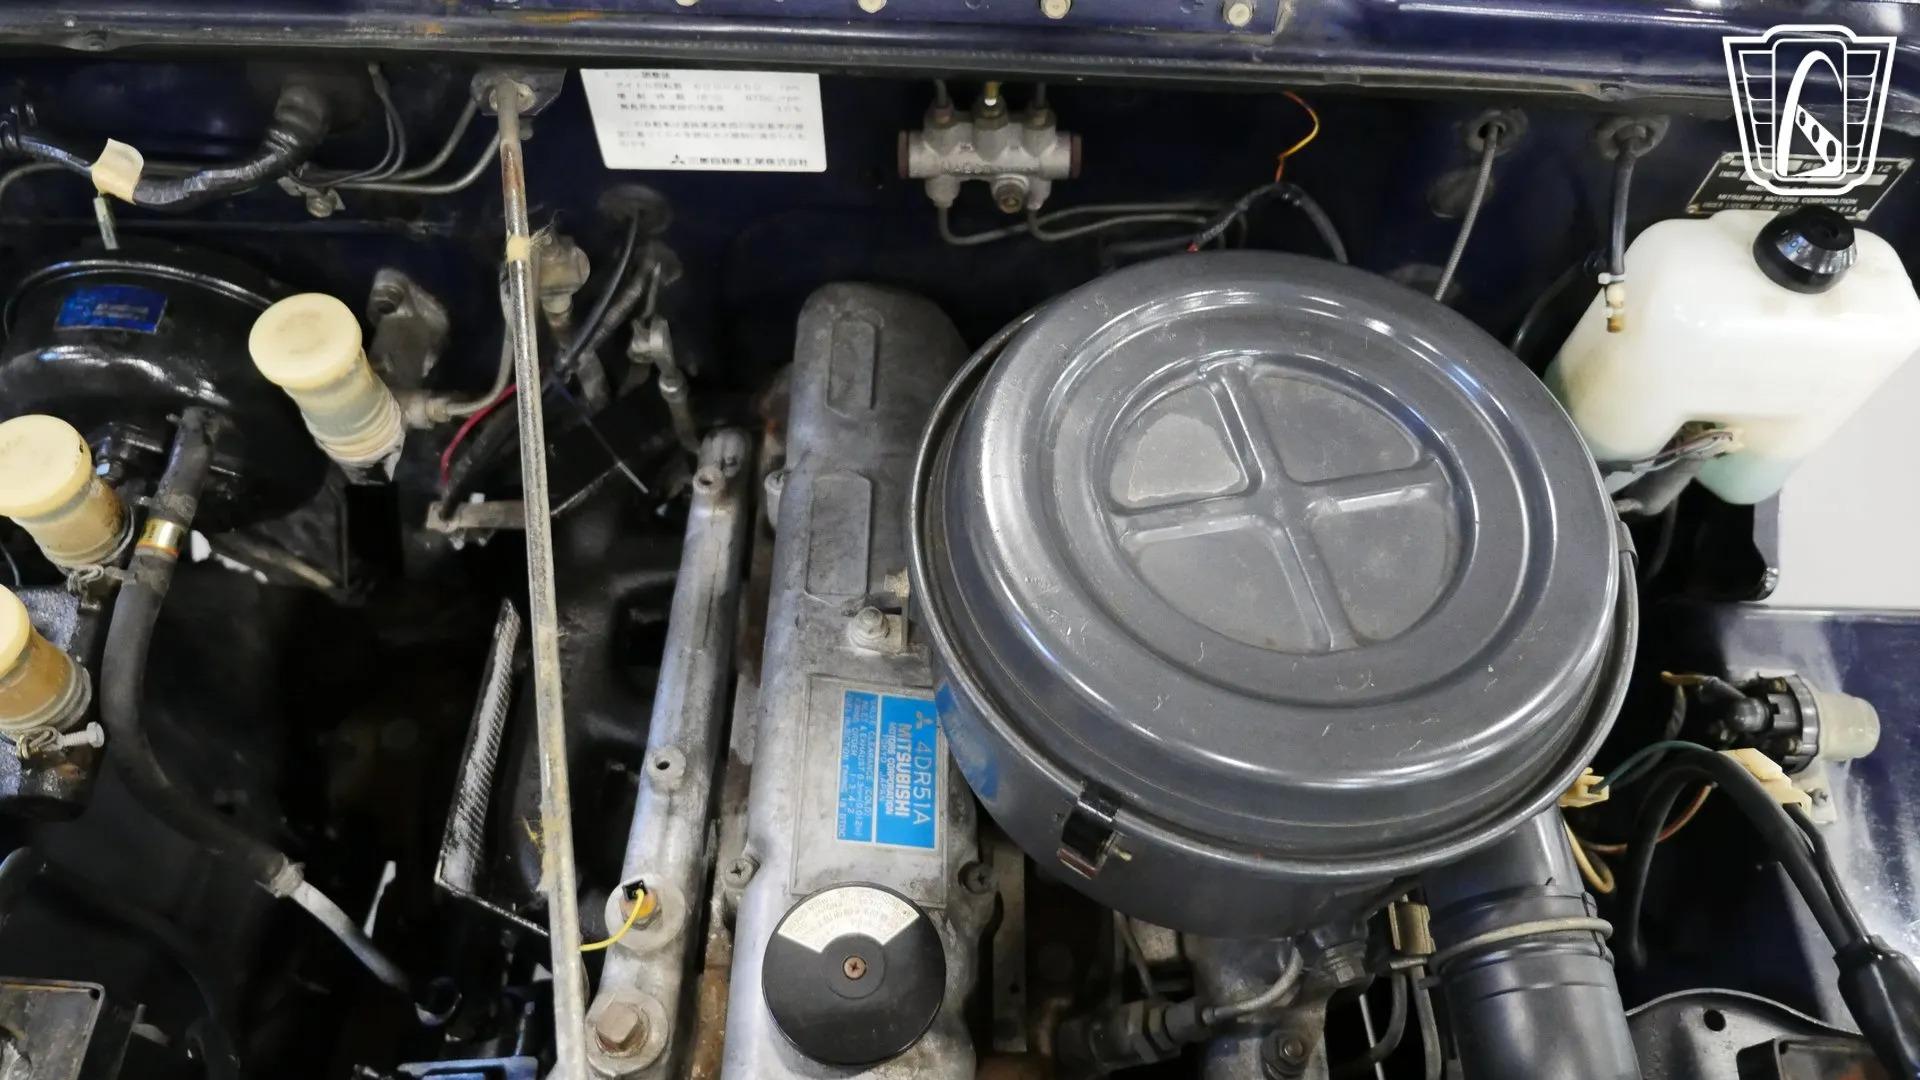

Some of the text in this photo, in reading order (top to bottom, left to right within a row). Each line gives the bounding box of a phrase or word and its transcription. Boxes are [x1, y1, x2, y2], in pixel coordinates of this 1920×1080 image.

[1716, 193, 1857, 204] MITSUBISHI MOTORS CORPORATION
[850, 728, 860, 757] ORDER
[857, 733, 867, 772] EXHAUST
[865, 731, 875, 784] CLEARANCE
[879, 734, 888, 802] TOKYO JAPAN
[885, 721, 897, 816] MOTORS CORPORATION
[895, 722, 913, 817] MITSUBISHI
[912, 741, 932, 826] 4DR51A
